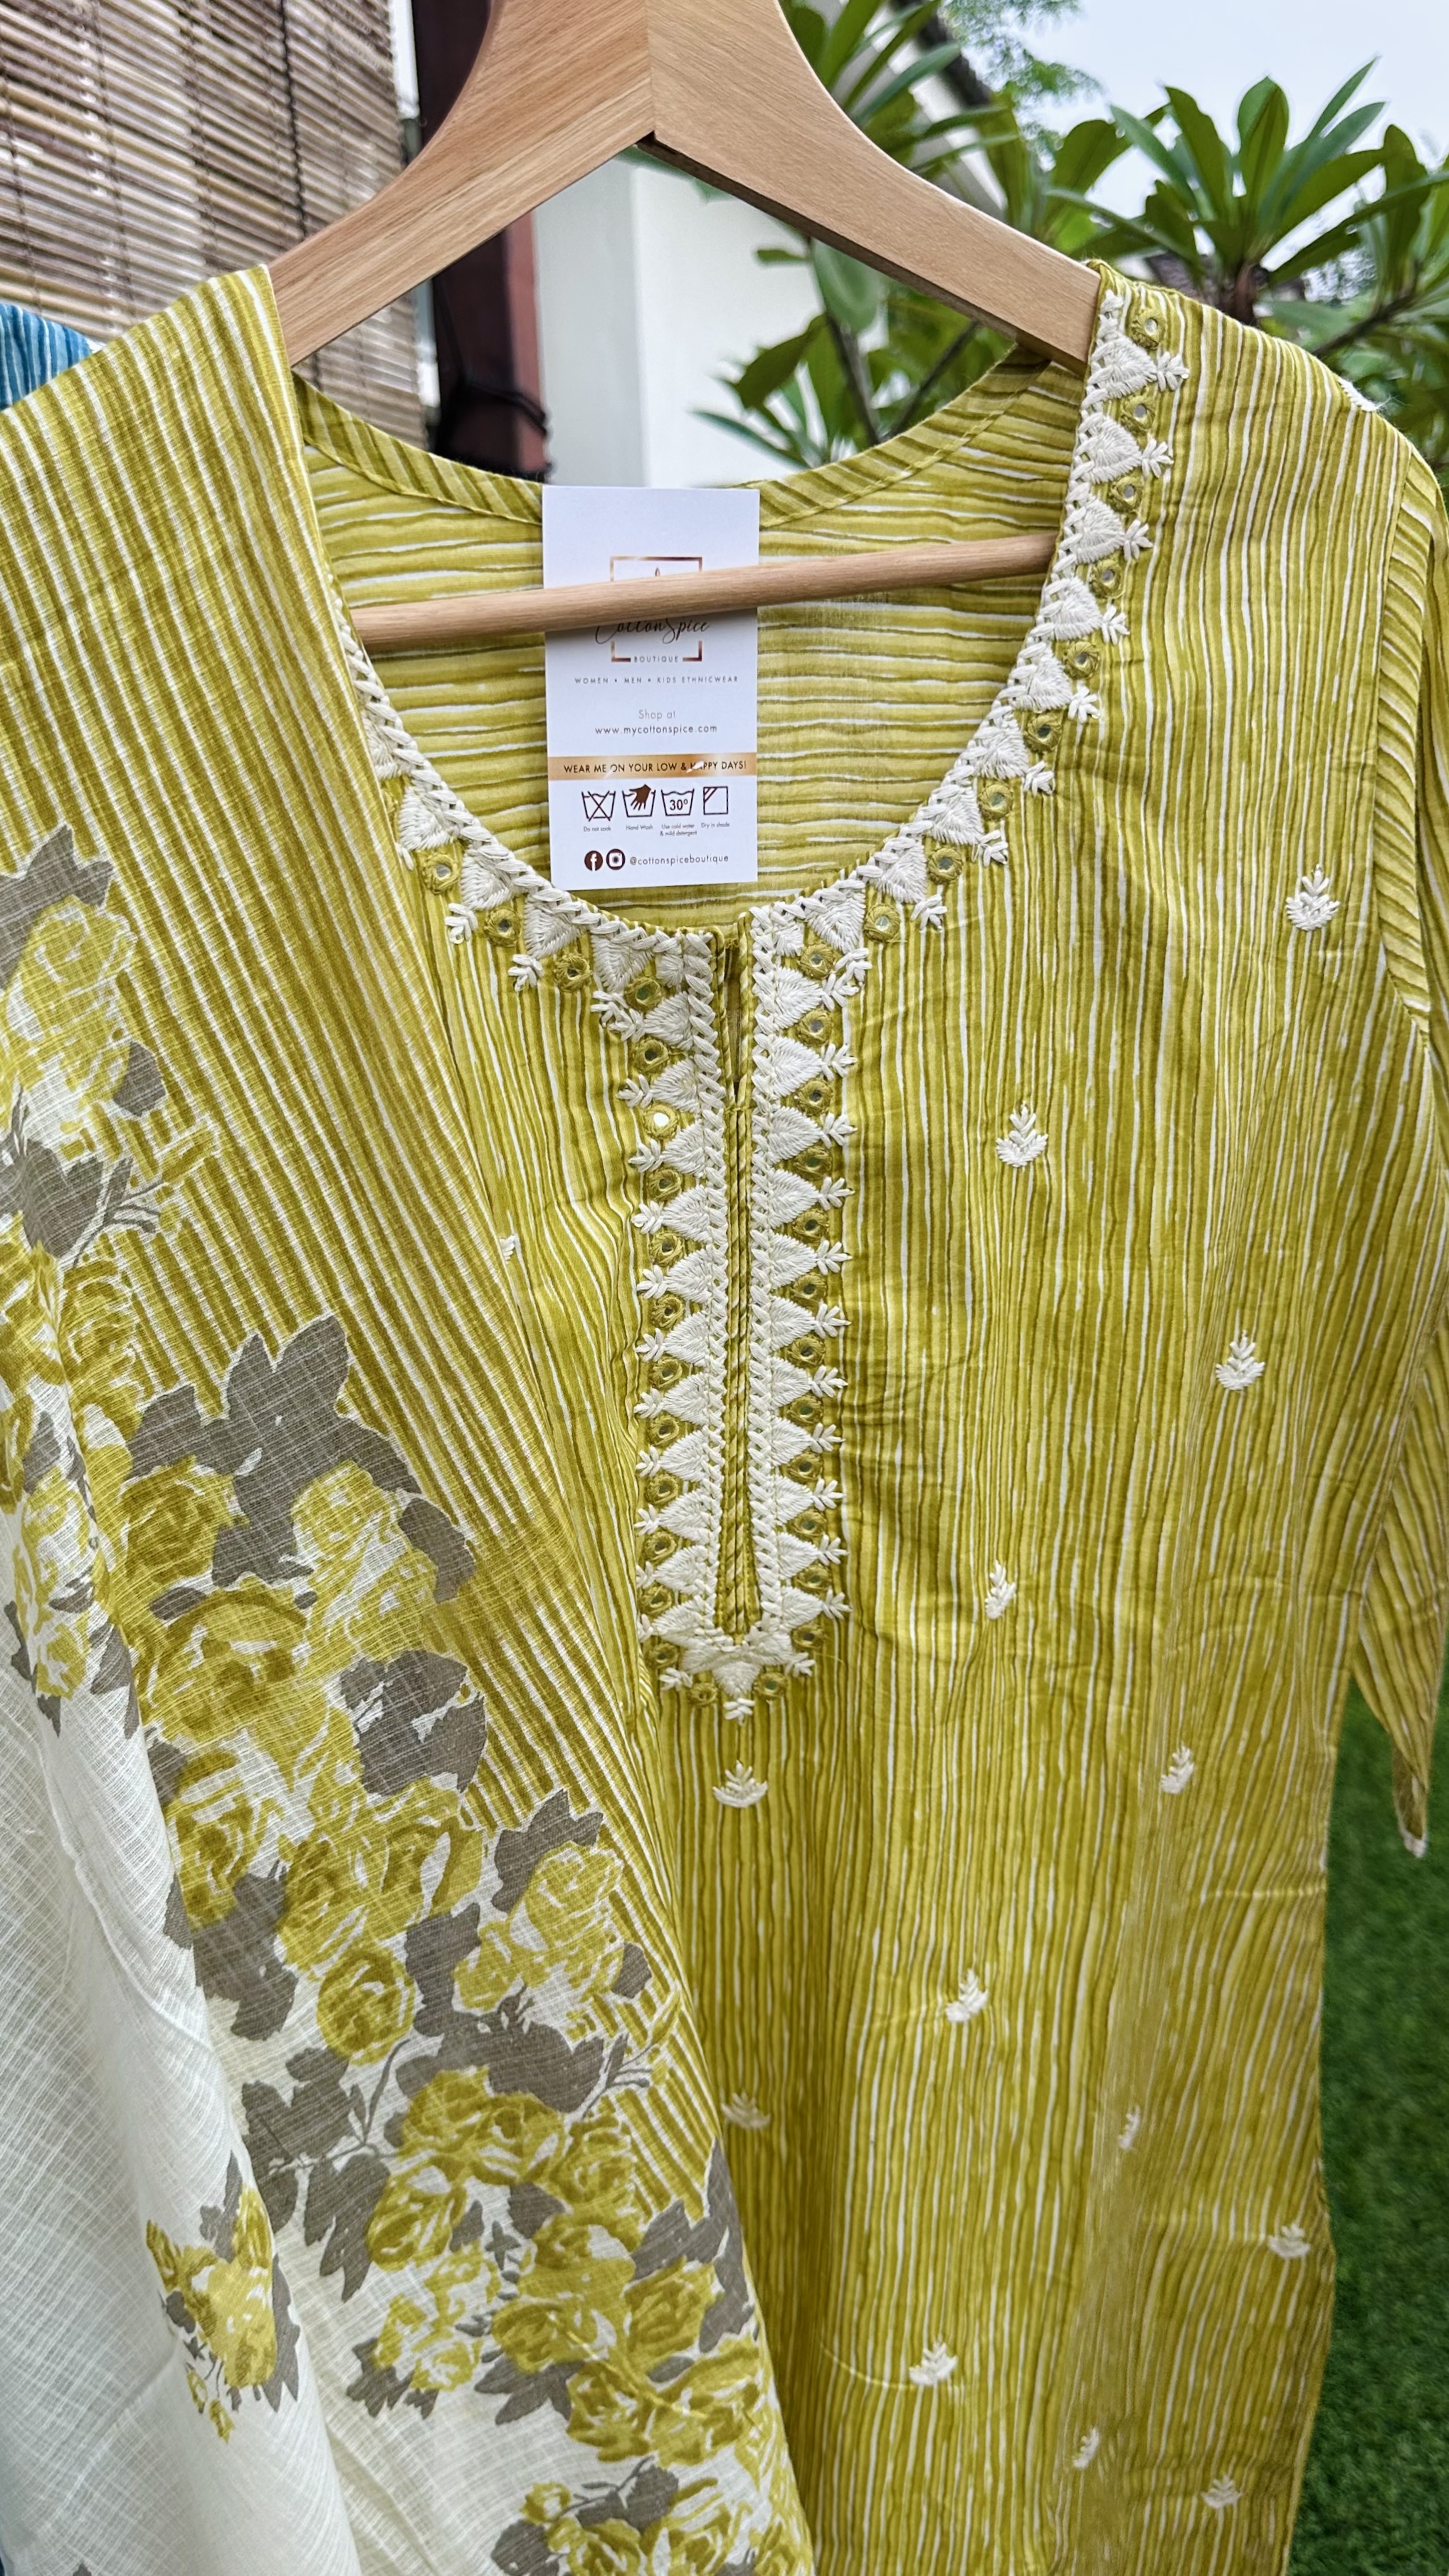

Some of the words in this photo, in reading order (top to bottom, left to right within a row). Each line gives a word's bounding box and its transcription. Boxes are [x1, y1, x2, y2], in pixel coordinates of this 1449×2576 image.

[638, 710, 663, 721] Shop
[666, 710, 676, 719] at
[595, 725, 717, 737] www.mycottonspice.com
[564, 764, 591, 773] WEAR
[594, 764, 606, 773] ME
[610, 764, 625, 772] ON
[628, 762, 653, 772] YOUR
[657, 762, 677, 771] LOW
[680, 762, 687, 771] &
[721, 760, 747, 769] DAYS!
[630, 853, 729, 866] @cottonspiceboutique
